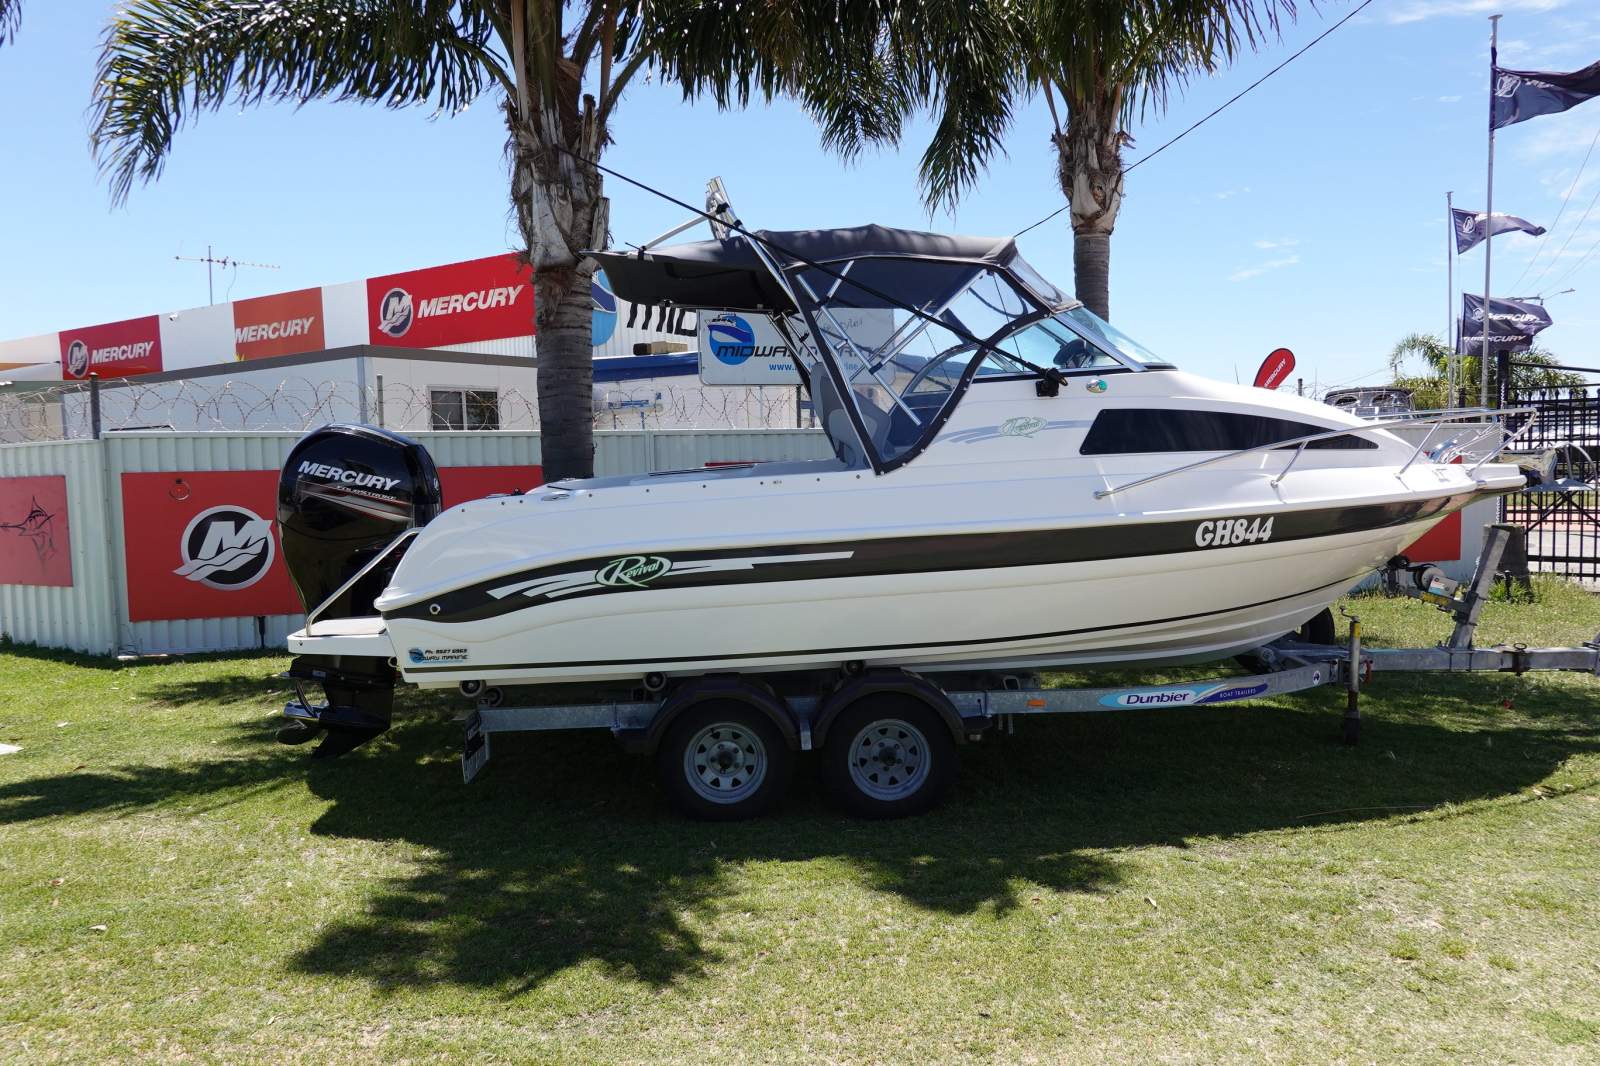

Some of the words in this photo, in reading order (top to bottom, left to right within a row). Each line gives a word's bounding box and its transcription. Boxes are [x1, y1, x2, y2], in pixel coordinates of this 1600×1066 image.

[417, 285, 524, 318] MERCURY
[234, 316, 315, 344] MERCURY
[91, 341, 154, 364] MERCURY
[715, 344, 803, 359] MIDWA
[1263, 358, 1287, 388] MERCURY
[298, 460, 401, 491] MERCURY
[1195, 516, 1274, 548] GH844
[603, 556, 660, 588] Revival
[1126, 692, 1189, 705] Dunbier
[1219, 690, 1234, 699] BOAT
[1235, 687, 1257, 696] TRAILERS
